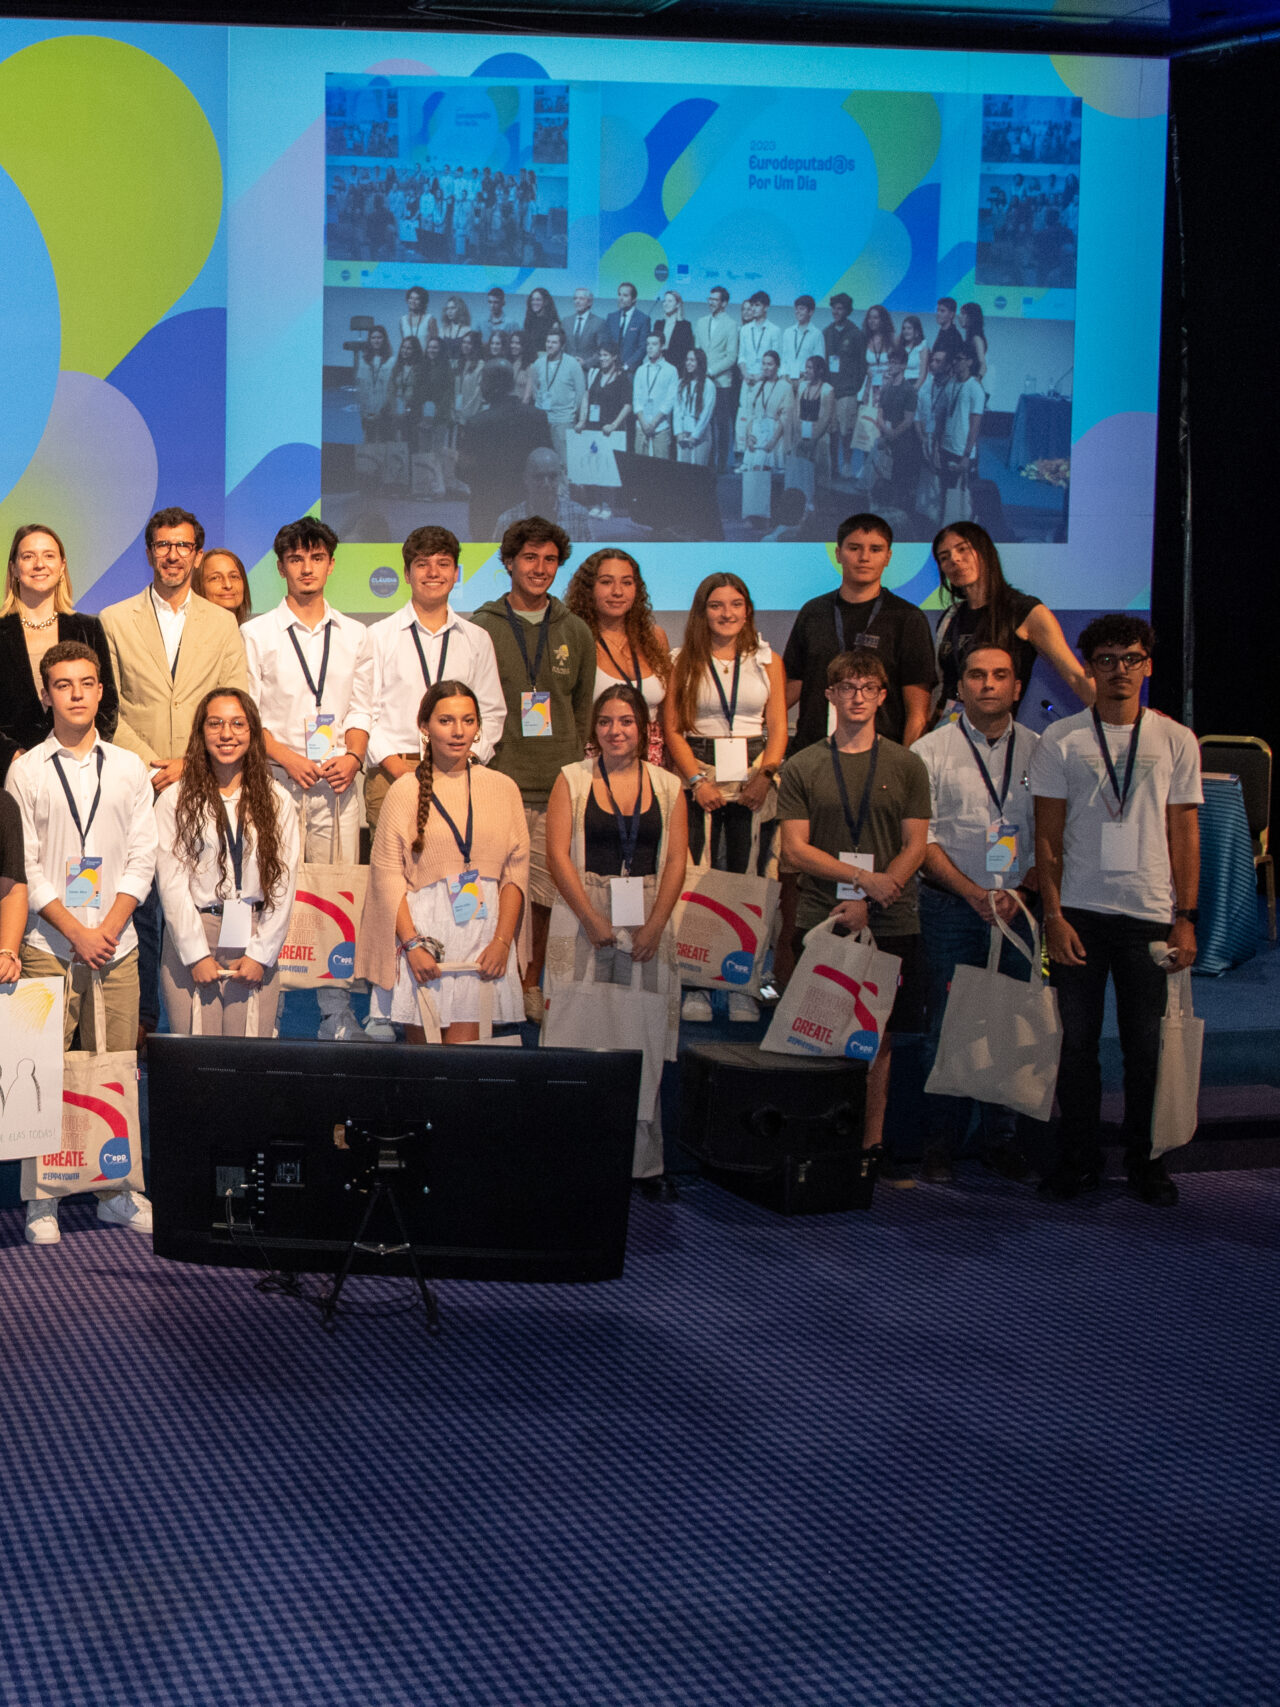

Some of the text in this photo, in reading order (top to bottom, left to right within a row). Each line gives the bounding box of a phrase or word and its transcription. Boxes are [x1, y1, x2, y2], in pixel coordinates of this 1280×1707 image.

[750, 141, 776, 151] 2023
[749, 174, 817, 190] Por Um Dia
[792, 1017, 833, 1045] CREATE.
[112, 1154, 126, 1162] epp
[42, 1172, 80, 1180] #EPP4YOUTH
